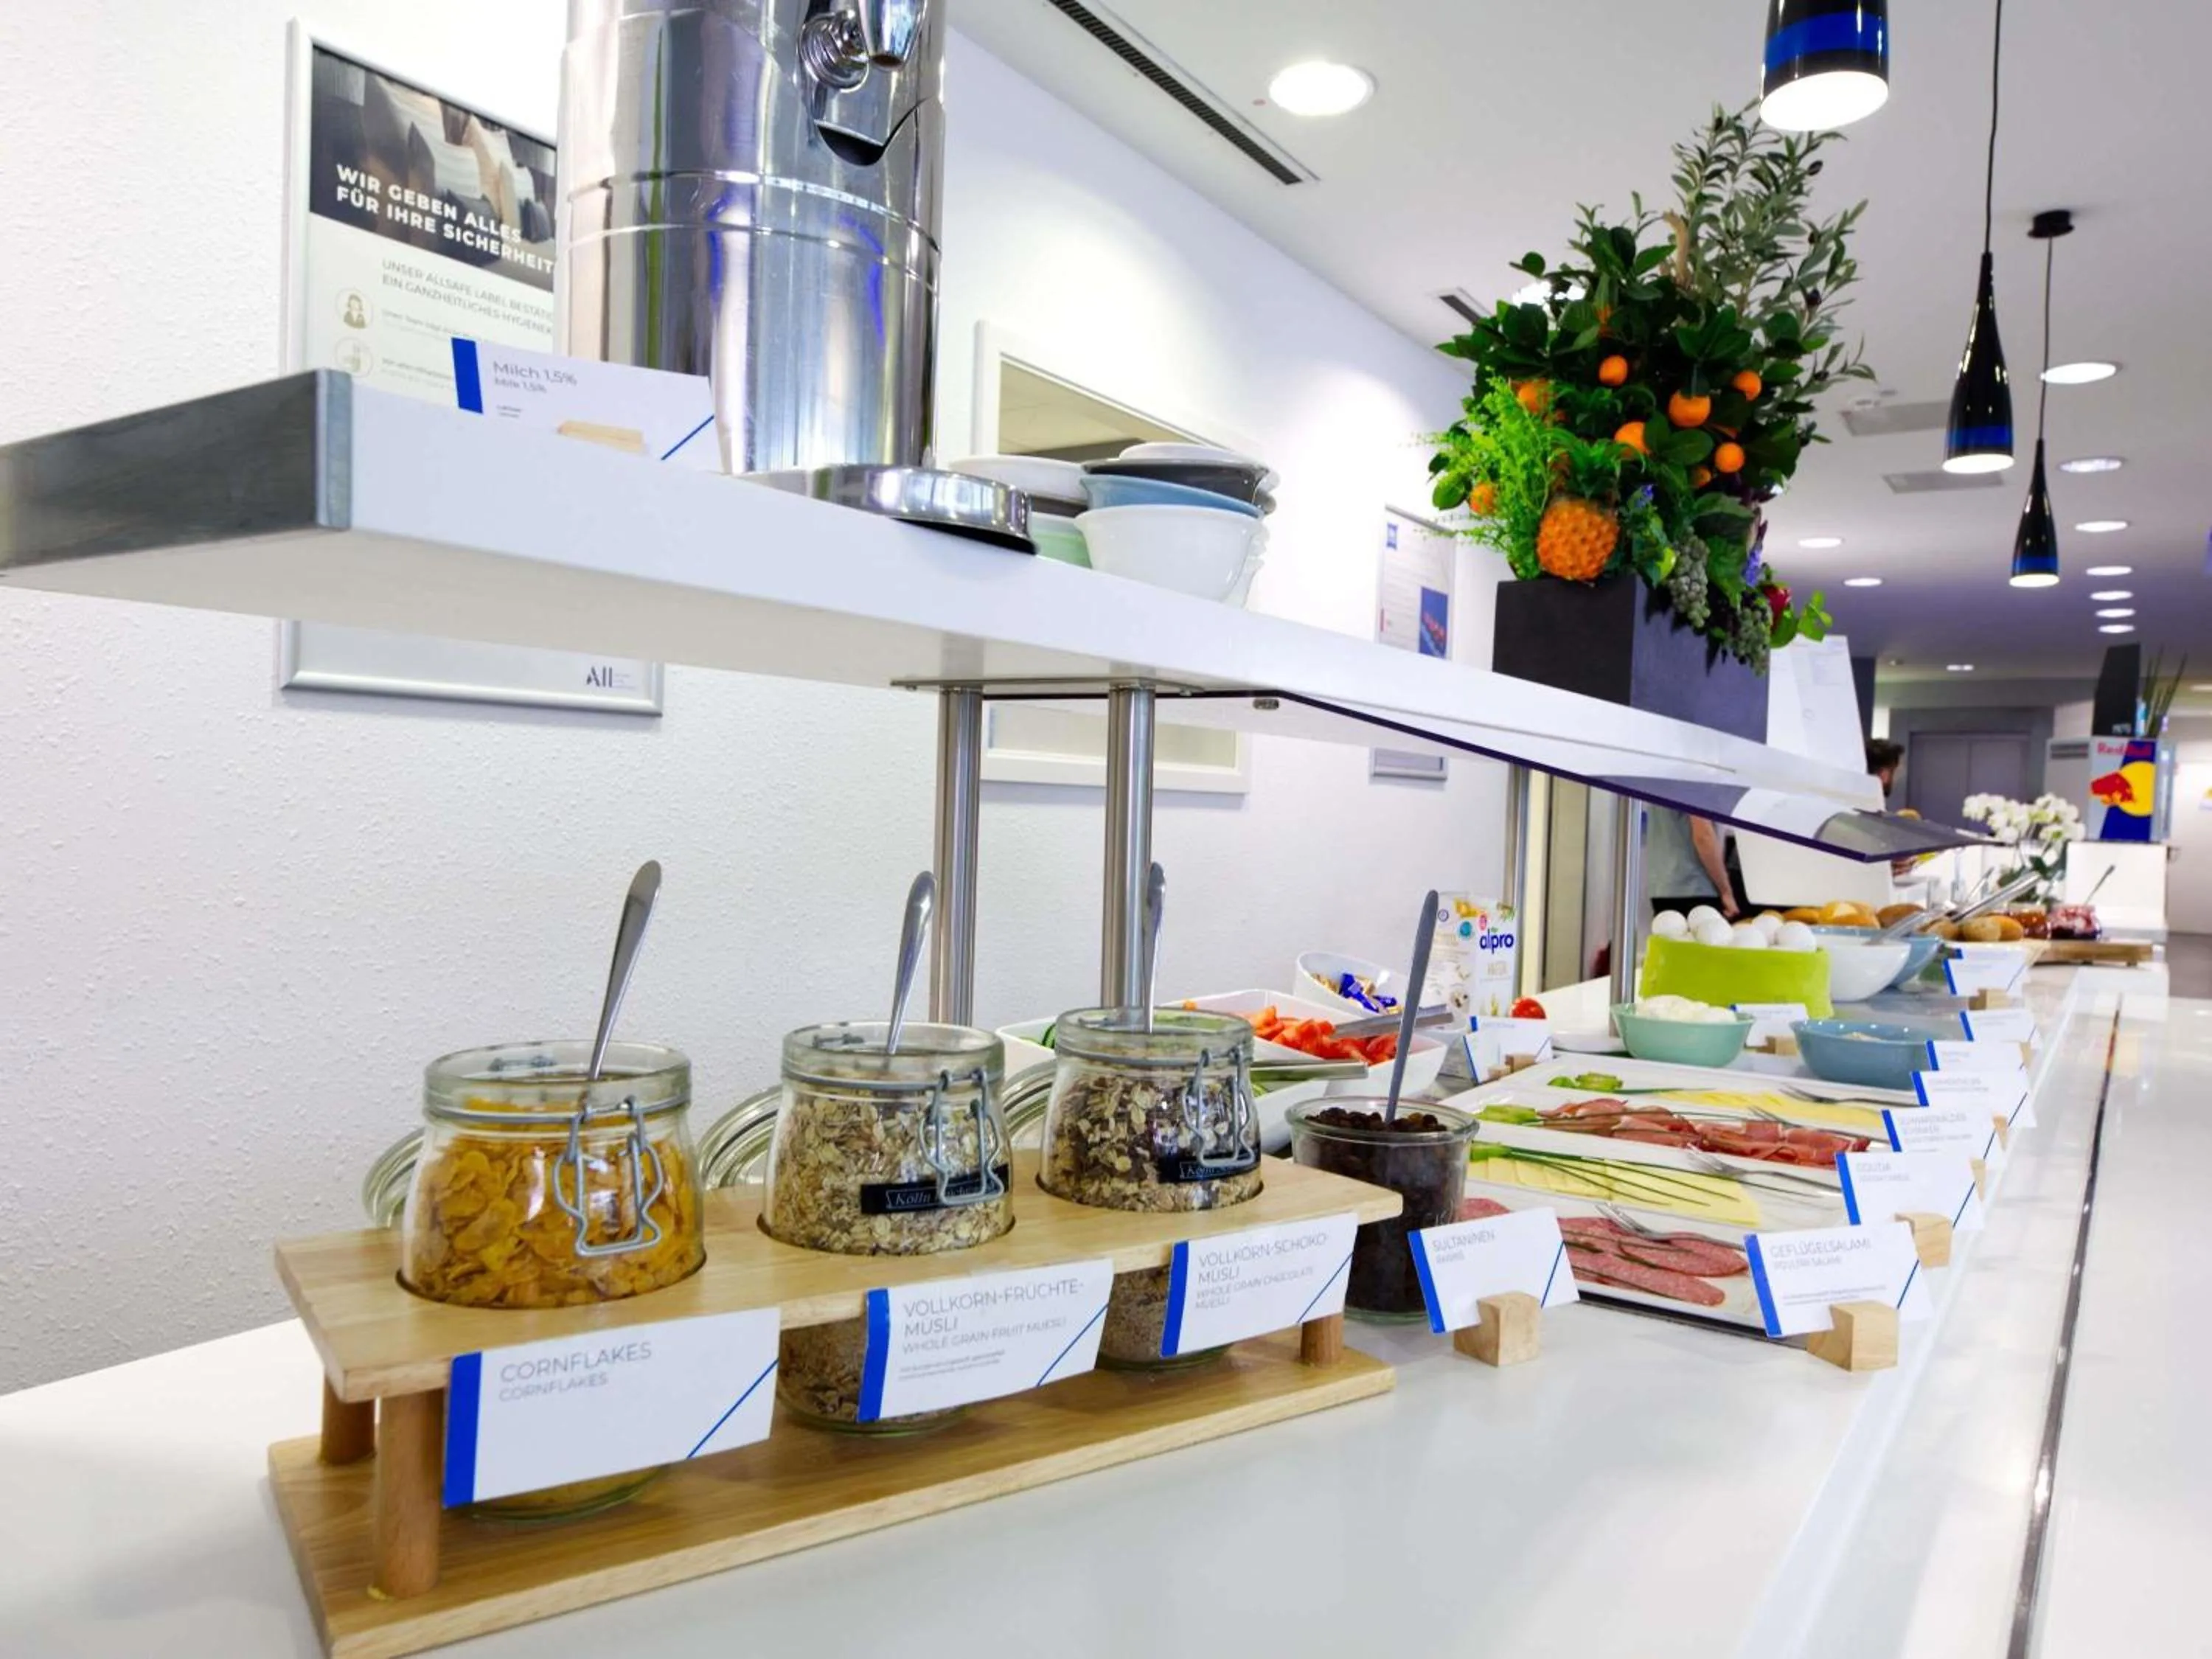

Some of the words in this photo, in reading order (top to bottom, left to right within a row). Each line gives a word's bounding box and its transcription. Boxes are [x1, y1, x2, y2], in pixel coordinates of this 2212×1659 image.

[336, 164, 380, 193] WIR
[388, 185, 457, 220] GEBEN
[464, 212, 521, 243] ALLES
[337, 186, 380, 214] FÜR
[386, 204, 437, 233] IHRE
[443, 223, 553, 274] SICHERHEIT
[382, 259, 422, 279] UNSER
[382, 274, 404, 288] EIN
[493, 361, 540, 379] Milch
[1480, 928, 1514, 953] alpro
[902, 1335, 948, 1355] WHOLE
[950, 1329, 990, 1347] GRAIN
[991, 1324, 1026, 1340] FRUIT
[501, 1341, 652, 1383] CORNFLAKES
[498, 1371, 609, 1402] CORNFLAKES
